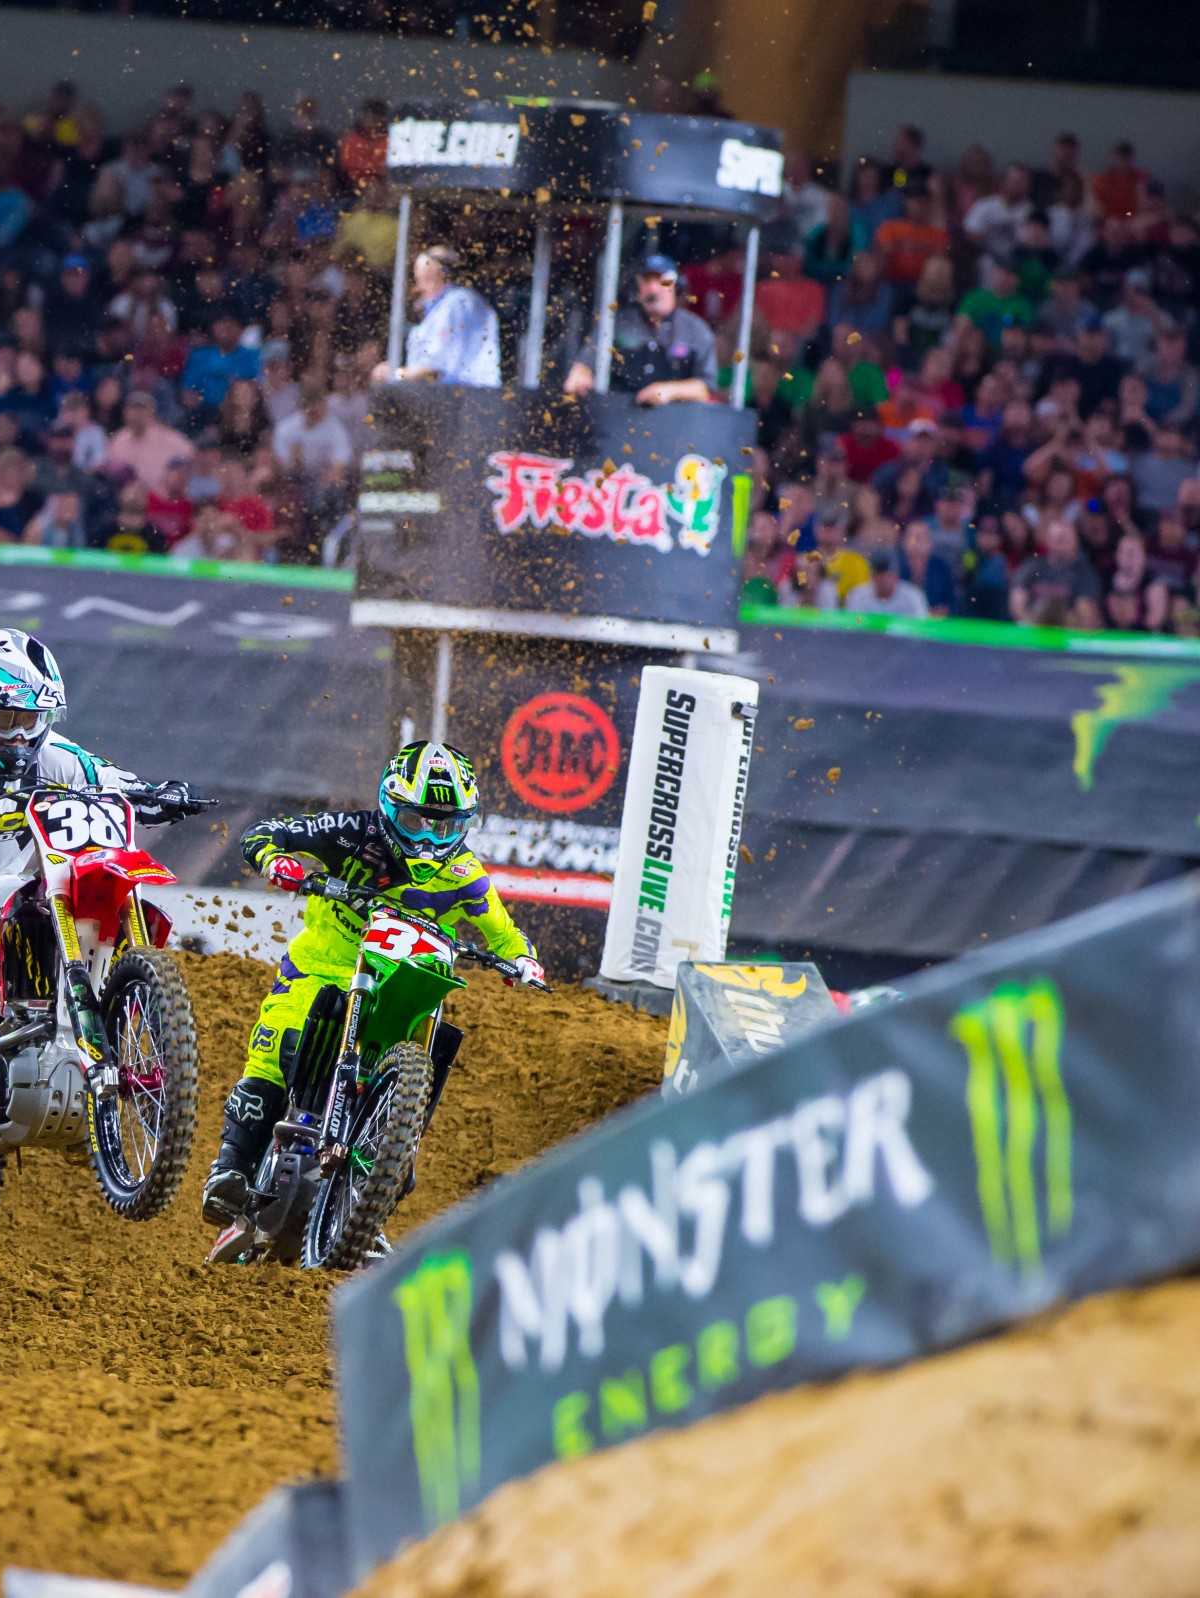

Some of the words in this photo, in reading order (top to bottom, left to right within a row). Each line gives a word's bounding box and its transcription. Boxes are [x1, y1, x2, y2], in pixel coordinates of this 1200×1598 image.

[487, 452, 673, 552] Fiesta
[2, 683, 34, 693] AMSOIL
[47, 800, 128, 851] 38
[363, 917, 459, 965] 37
[86, 1090, 100, 1154] DUNLOP
[494, 1068, 934, 1376] MONSTER
[552, 1272, 867, 1462] ENERGY
